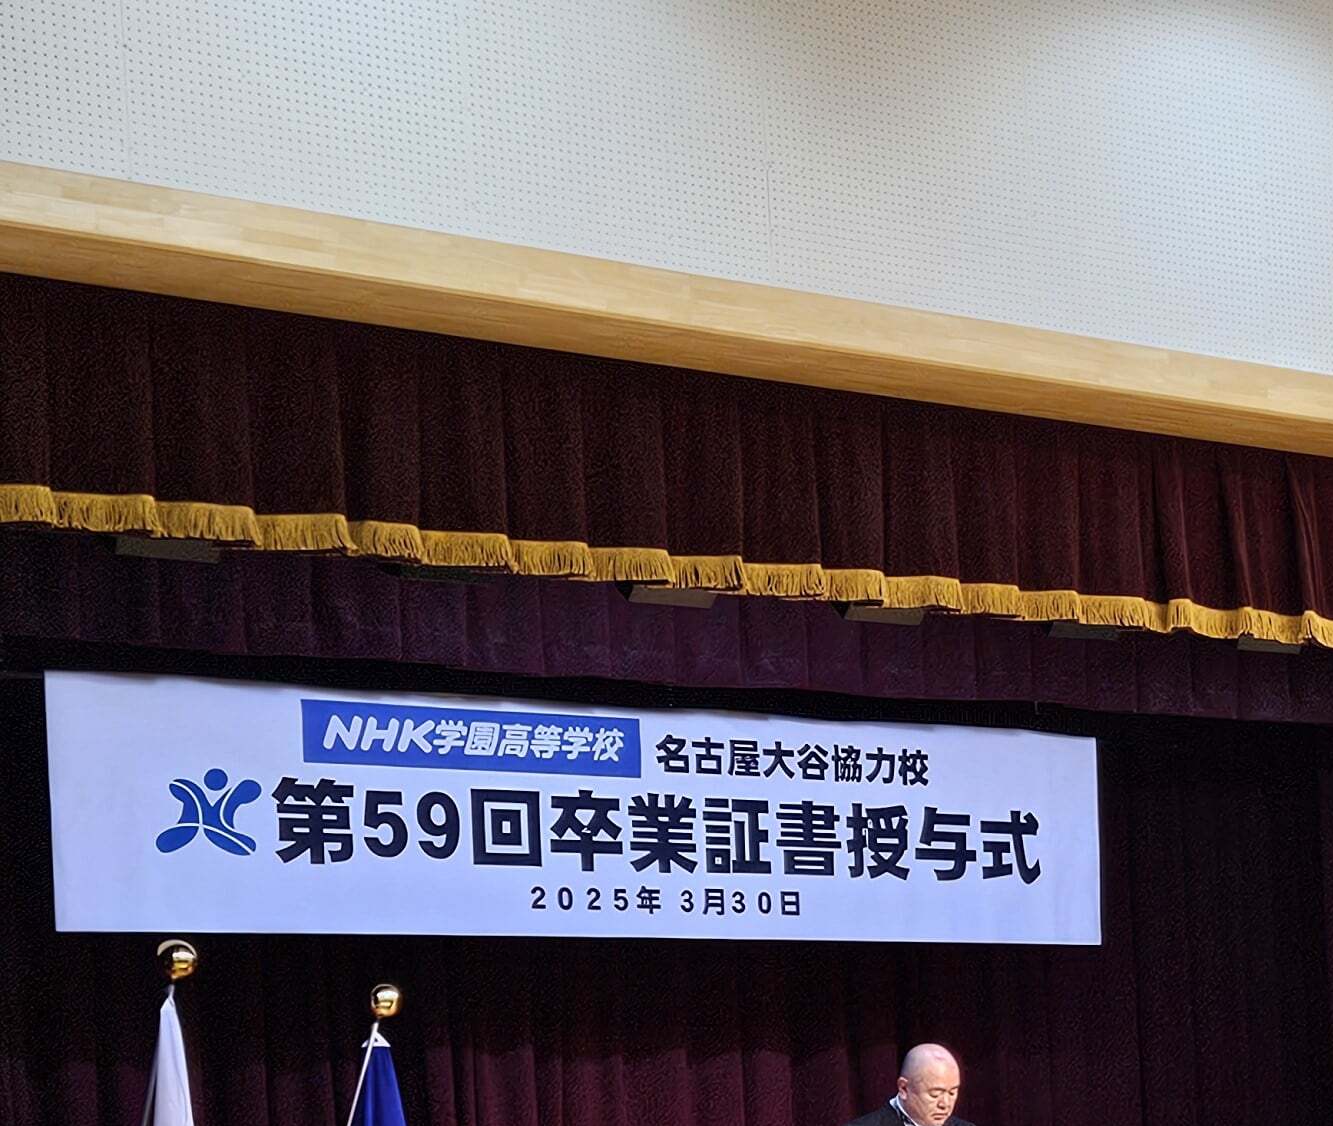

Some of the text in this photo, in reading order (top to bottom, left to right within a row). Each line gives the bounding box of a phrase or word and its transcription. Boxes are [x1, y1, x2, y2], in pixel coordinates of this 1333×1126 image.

[323, 713, 626, 762] NHK学園高等学校
[655, 734, 930, 787] 名古屋大谷協力校
[271, 776, 1041, 885] 第59回卒業証書授与式
